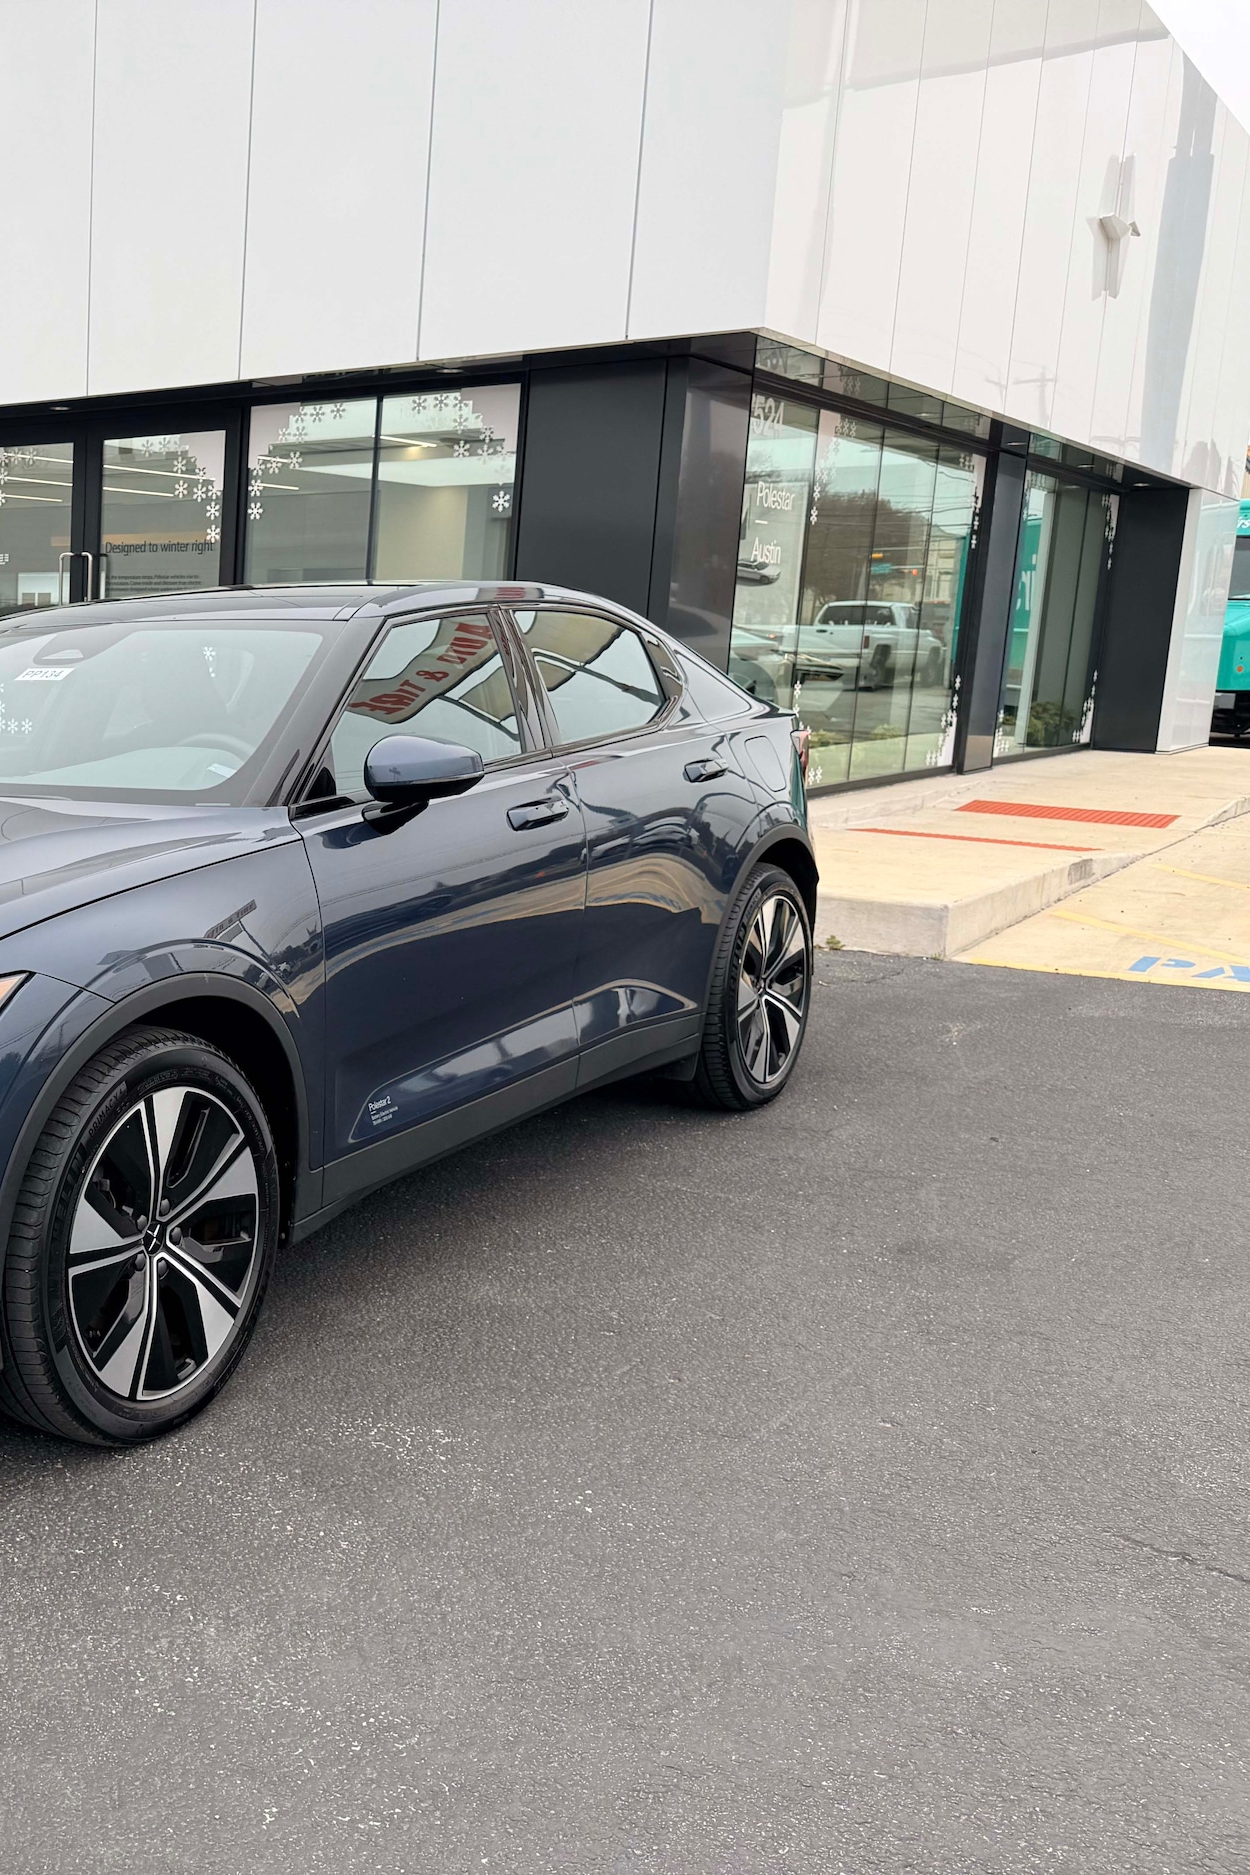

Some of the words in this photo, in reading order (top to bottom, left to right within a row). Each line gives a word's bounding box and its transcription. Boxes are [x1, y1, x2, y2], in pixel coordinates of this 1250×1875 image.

[756, 481, 795, 511] Polestar
[105, 541, 147, 556] Designed
[148, 542, 158, 552] to
[161, 540, 189, 553] winter
[191, 539, 214, 554] right
[750, 537, 781, 564] Austin
[21, 670, 64, 678] PP134
[368, 1099, 387, 1111] Polestar
[386, 1095, 391, 1104] 2
[88, 1093, 118, 1137] PRIMACY
